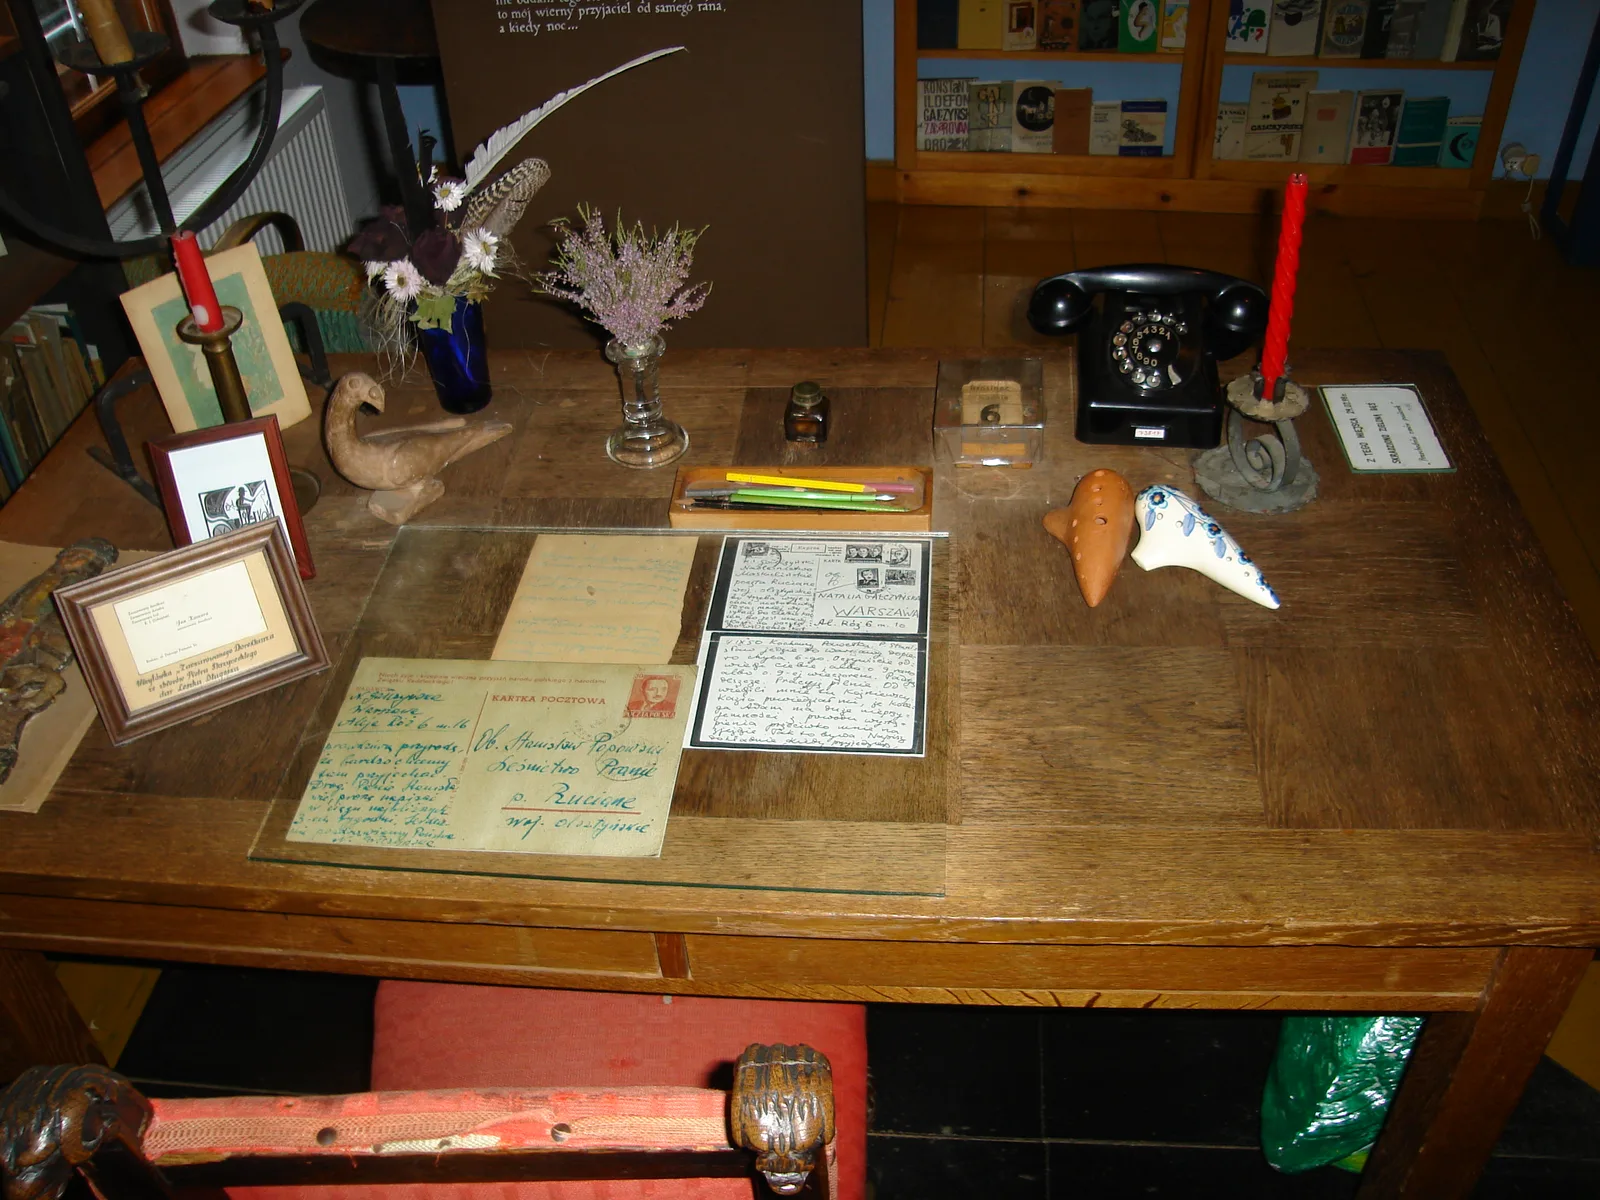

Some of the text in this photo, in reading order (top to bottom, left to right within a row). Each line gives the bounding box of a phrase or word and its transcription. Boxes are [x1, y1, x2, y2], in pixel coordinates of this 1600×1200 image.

[498, 11, 508, 20] to
[511, 8, 531, 22] mój
[536, 7, 573, 21] wierny
[578, 4, 631, 20] przyjaciel
[637, 3, 651, 14] od
[655, 4, 693, 17] samego
[509, 22, 541, 36] kiedy
[924, 94, 970, 107] ILDEFON
[980, 404, 1001, 425] 6
[1349, 417, 1365, 438] MIEJSCA
[1359, 442, 1373, 456] TEGO
[1381, 434, 1401, 464] SKRADZIONO
[833, 605, 918, 618] WARSZAWA
[491, 694, 606, 705] KARTKA POCZTOWA
[504, 730, 586, 752] Stanisław
[596, 758, 658, 778] Pranie
[544, 782, 637, 810] Ruciane
